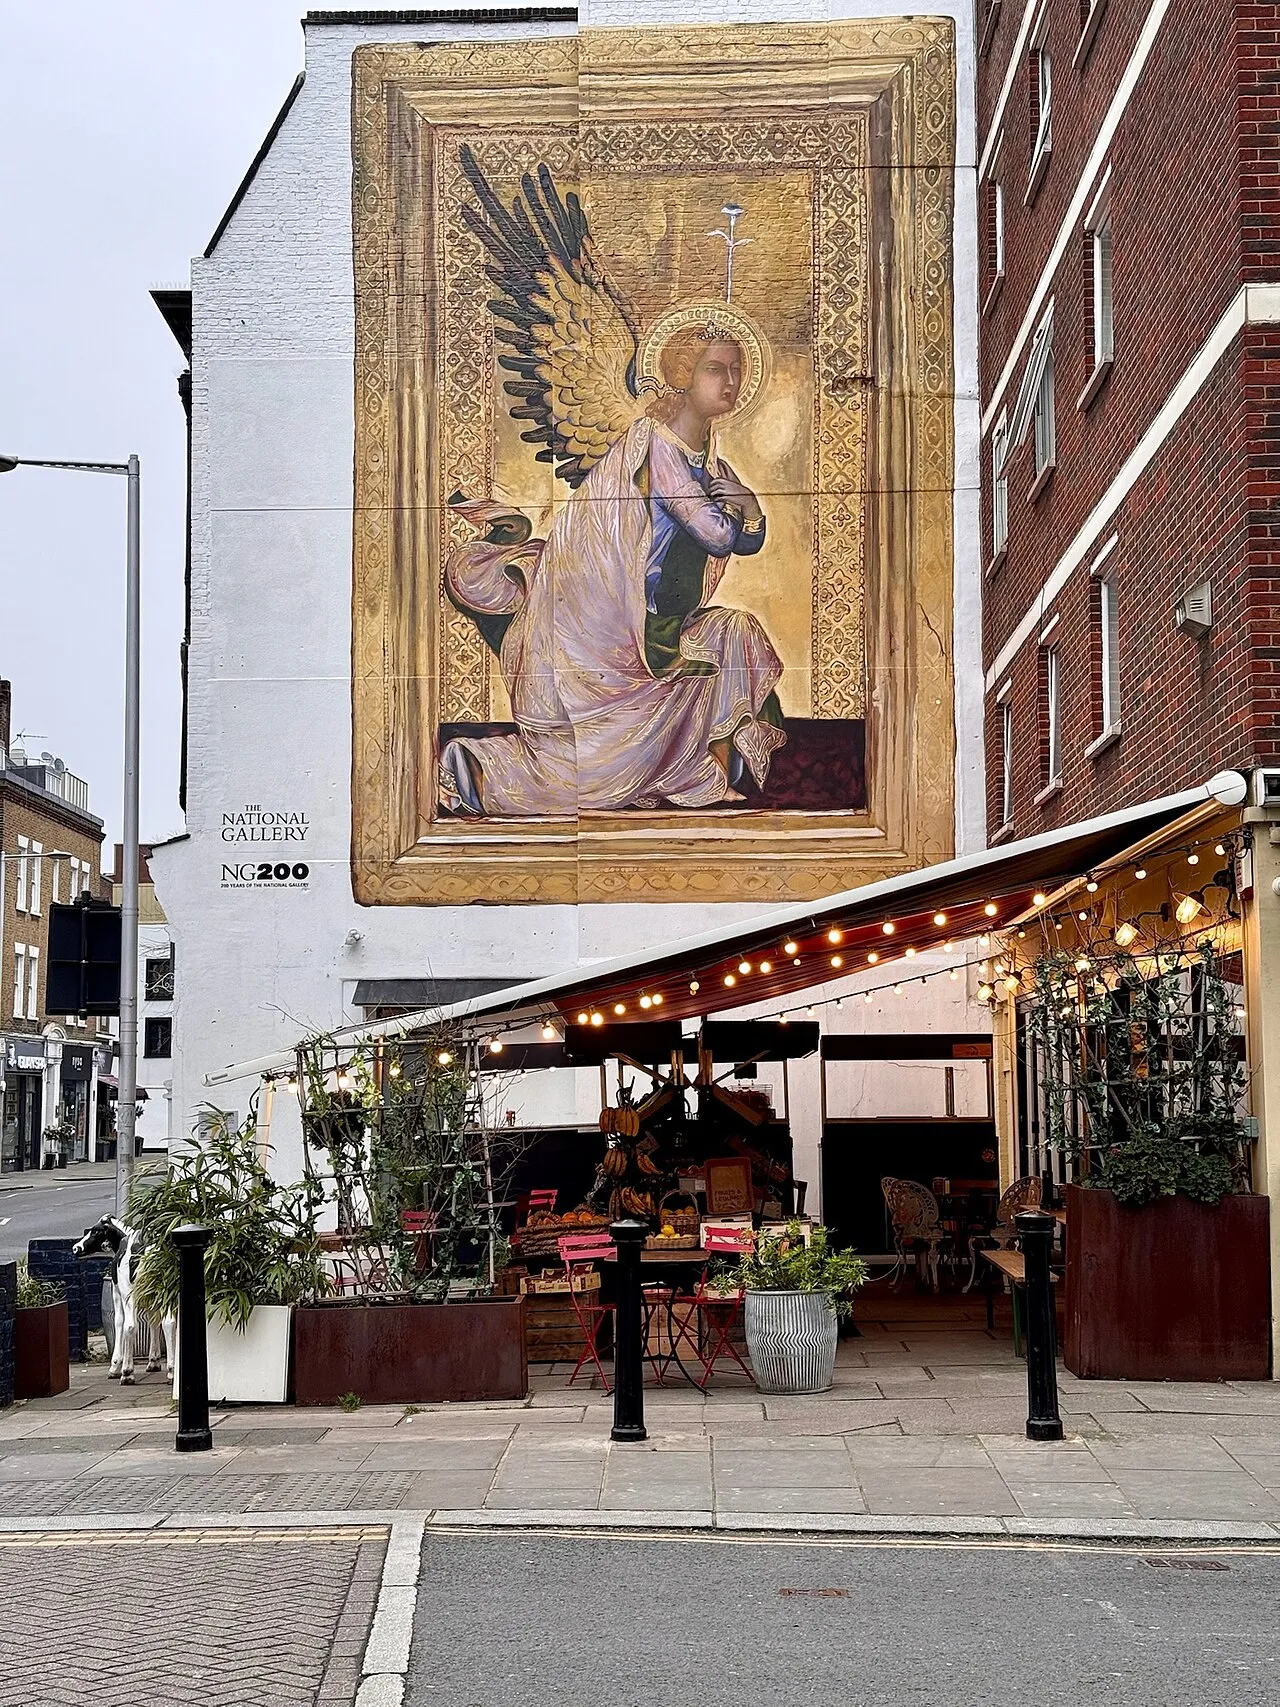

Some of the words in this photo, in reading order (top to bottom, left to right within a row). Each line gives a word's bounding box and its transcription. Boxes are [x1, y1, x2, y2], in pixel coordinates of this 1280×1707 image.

[222, 812, 310, 825] NATIONAL
[221, 827, 309, 841] GALLERY
[221, 863, 309, 881] NG200
